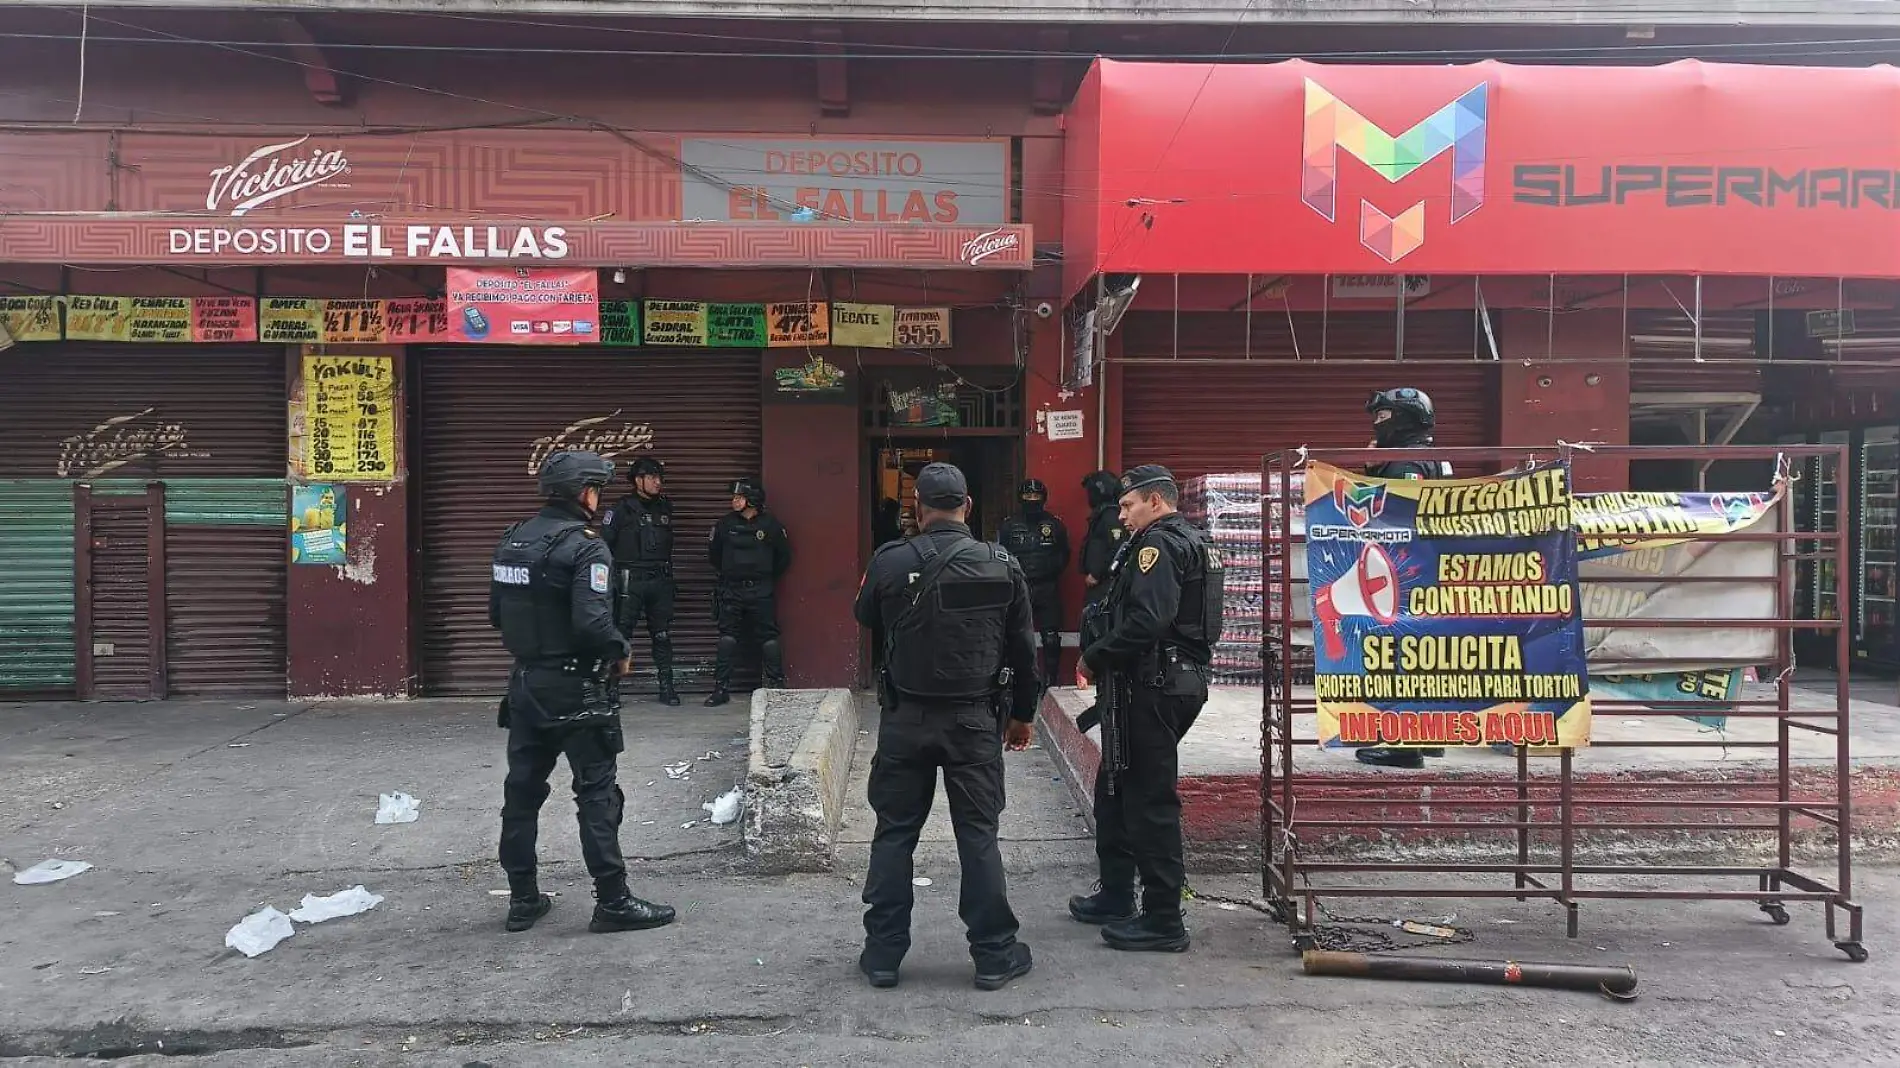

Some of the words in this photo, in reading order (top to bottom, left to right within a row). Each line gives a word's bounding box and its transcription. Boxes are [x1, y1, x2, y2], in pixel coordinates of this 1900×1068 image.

[207, 134, 347, 216] Victoria
[765, 149, 922, 177] DEPOSITO
[1513, 164, 1900, 210] SUPERMAR
[729, 188, 769, 222] EL
[795, 189, 960, 224] FALLAS
[169, 229, 332, 254] DEPOSITO
[344, 225, 392, 257] EL
[407, 225, 569, 259] FALLAS
[961, 227, 1018, 265] Victoria
[452, 291, 464, 303] YA
[465, 291, 510, 303] RECIBIMOS
[511, 292, 537, 304] PAGO
[538, 292, 556, 303] CON
[558, 292, 594, 304] TARJETA
[834, 307, 880, 325] TECATE
[898, 324, 941, 345] 355
[312, 360, 386, 380] YAKULT
[358, 450, 379, 461] 174
[1417, 468, 1566, 515] INTEGRATE
[1310, 525, 1412, 542] SUPERMARMOTA
[1426, 511, 1507, 536] NUESTRO
[1509, 507, 1570, 535] EQUIPO
[1438, 552, 1543, 582] ESTAMOS
[1409, 585, 1573, 616] CONTRATANDO
[1363, 635, 1396, 671] SE
[1401, 635, 1523, 671] SOLICITA
[1318, 674, 1362, 699] CHOFER
[1364, 676, 1392, 698] CON
[1396, 675, 1482, 698] EXPERIENCIA
[1484, 674, 1522, 698] PARA
[1525, 674, 1580, 698] TORTON
[1339, 711, 1481, 743] INFORMES
[1486, 711, 1557, 745] AQUI
